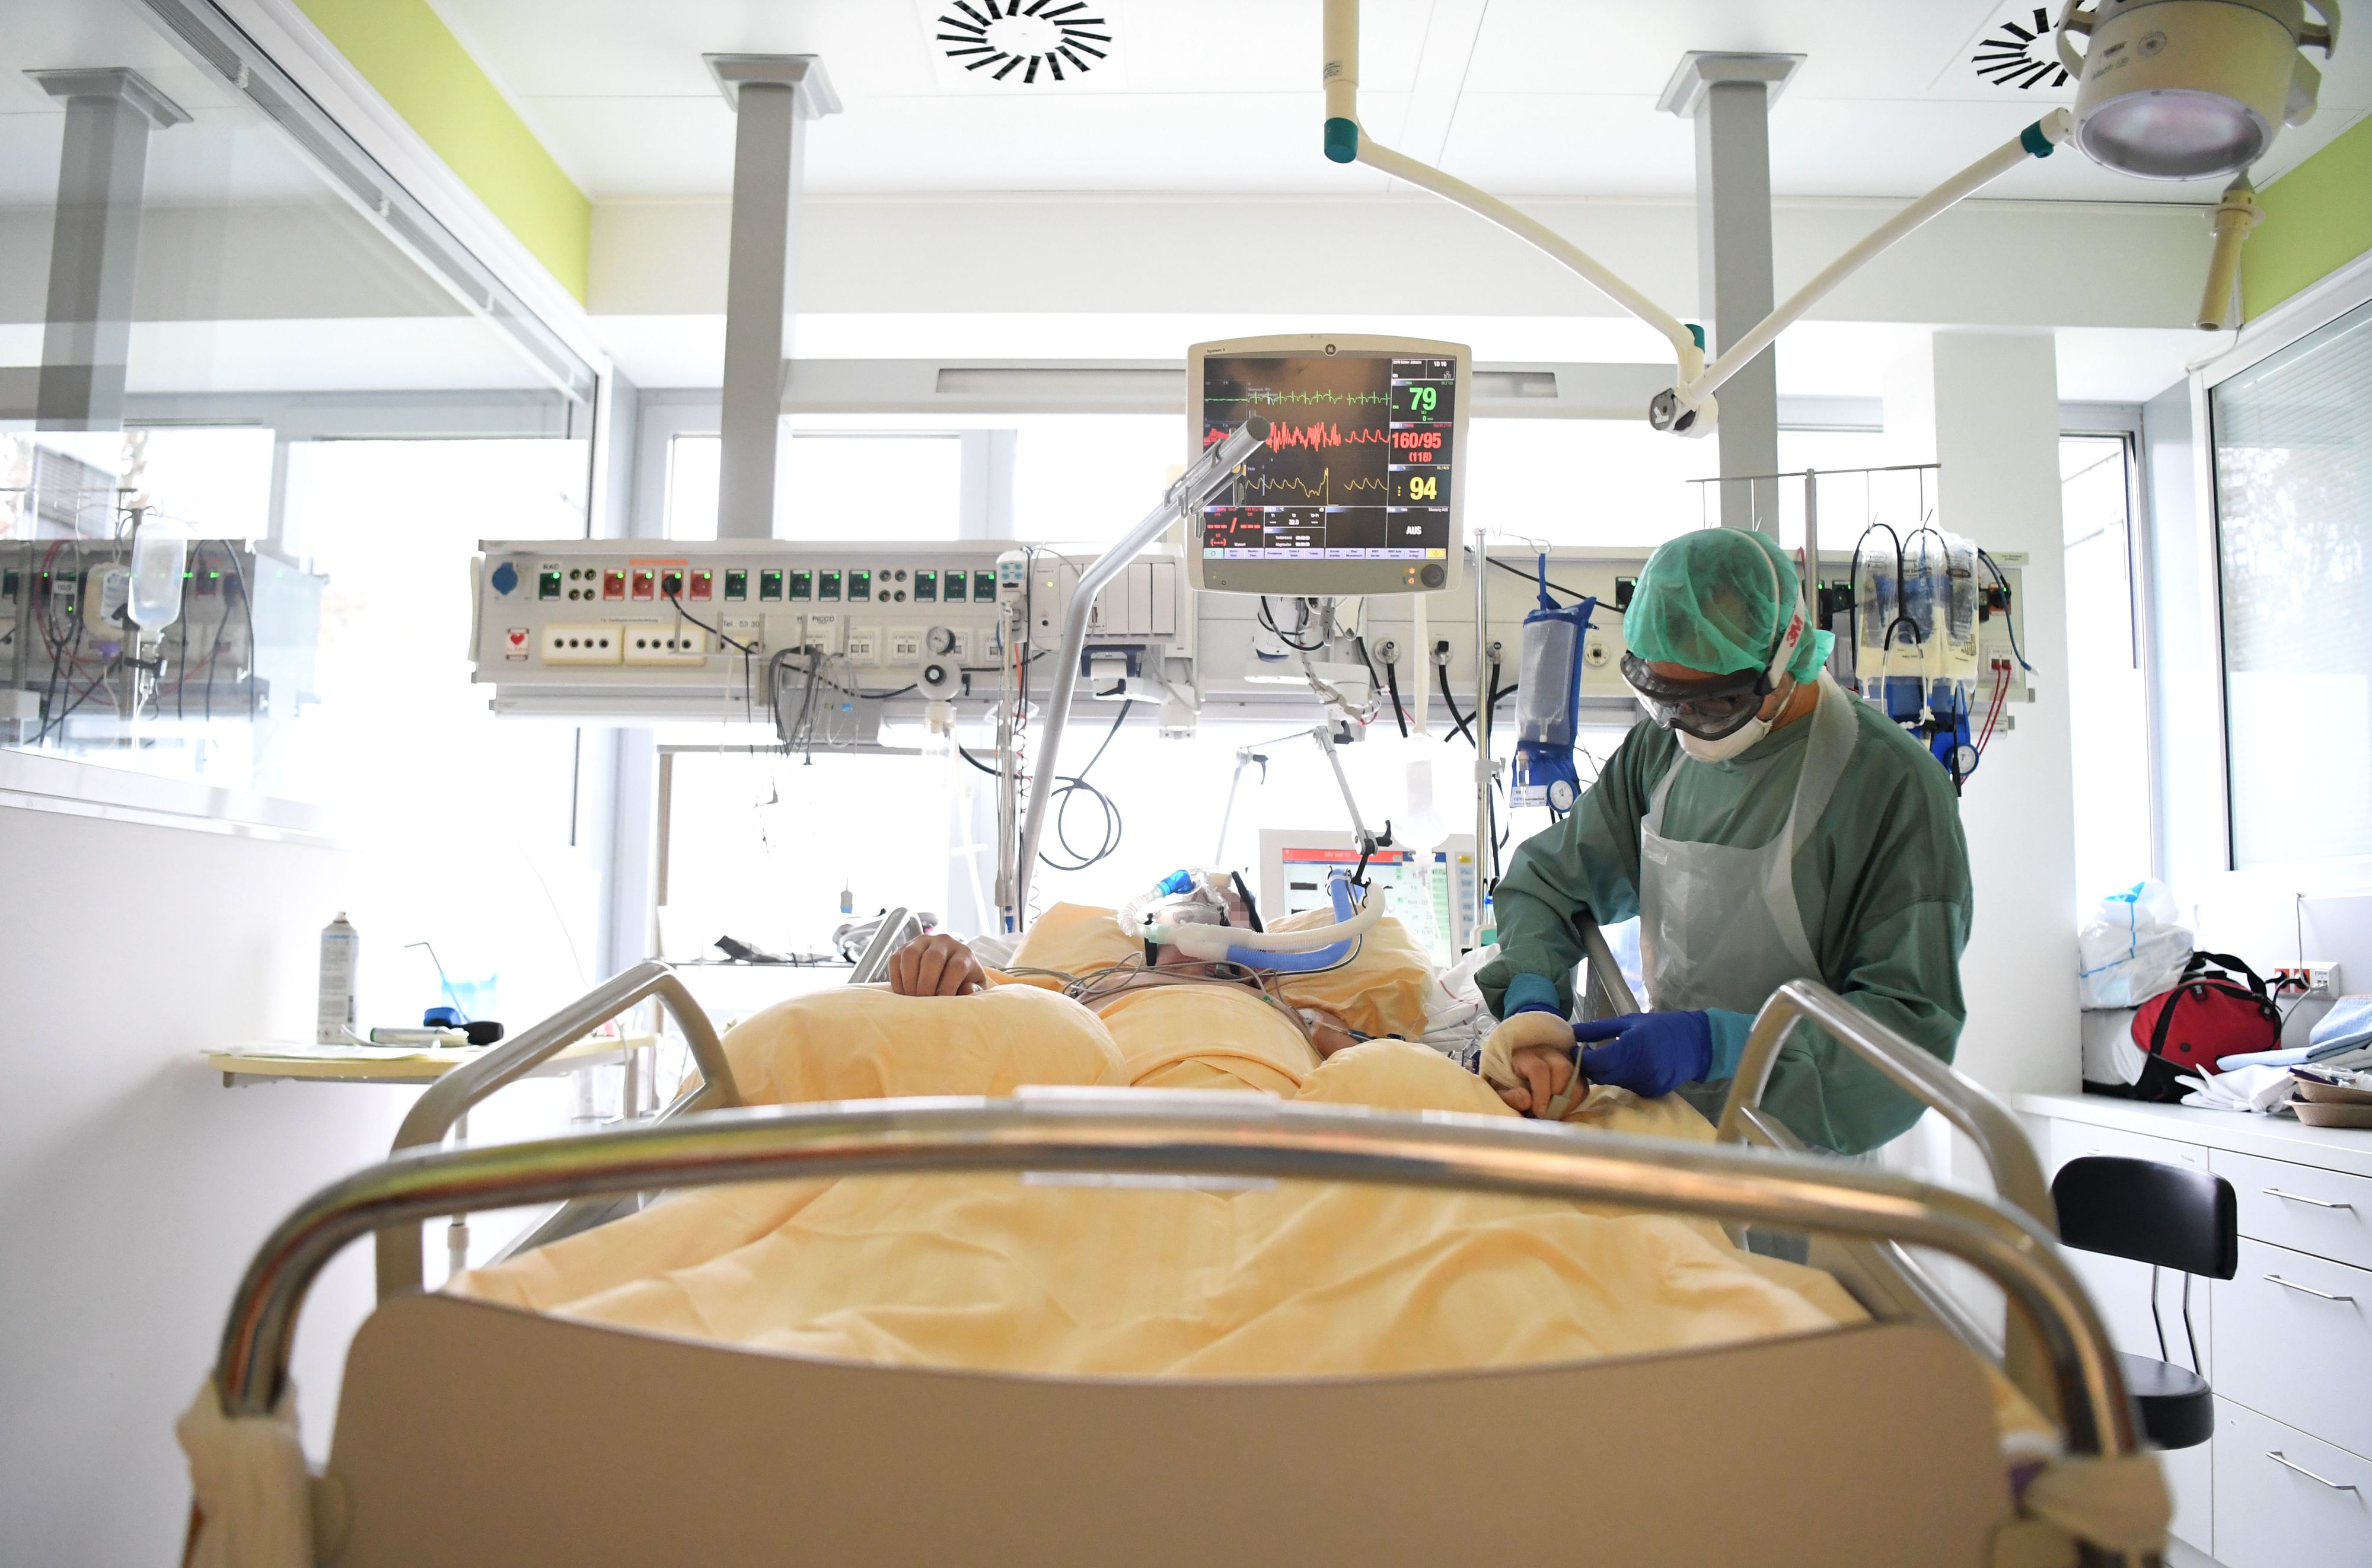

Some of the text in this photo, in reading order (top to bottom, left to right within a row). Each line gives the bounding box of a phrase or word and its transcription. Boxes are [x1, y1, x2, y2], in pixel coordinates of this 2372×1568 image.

[1410, 387, 1436, 410] 79
[1392, 432, 1442, 448] 160/95
[1409, 452, 1432, 462] (118)
[1410, 477, 1437, 500] 94
[1406, 526, 1422, 535] AUS
[1787, 614, 1803, 647] 3M
